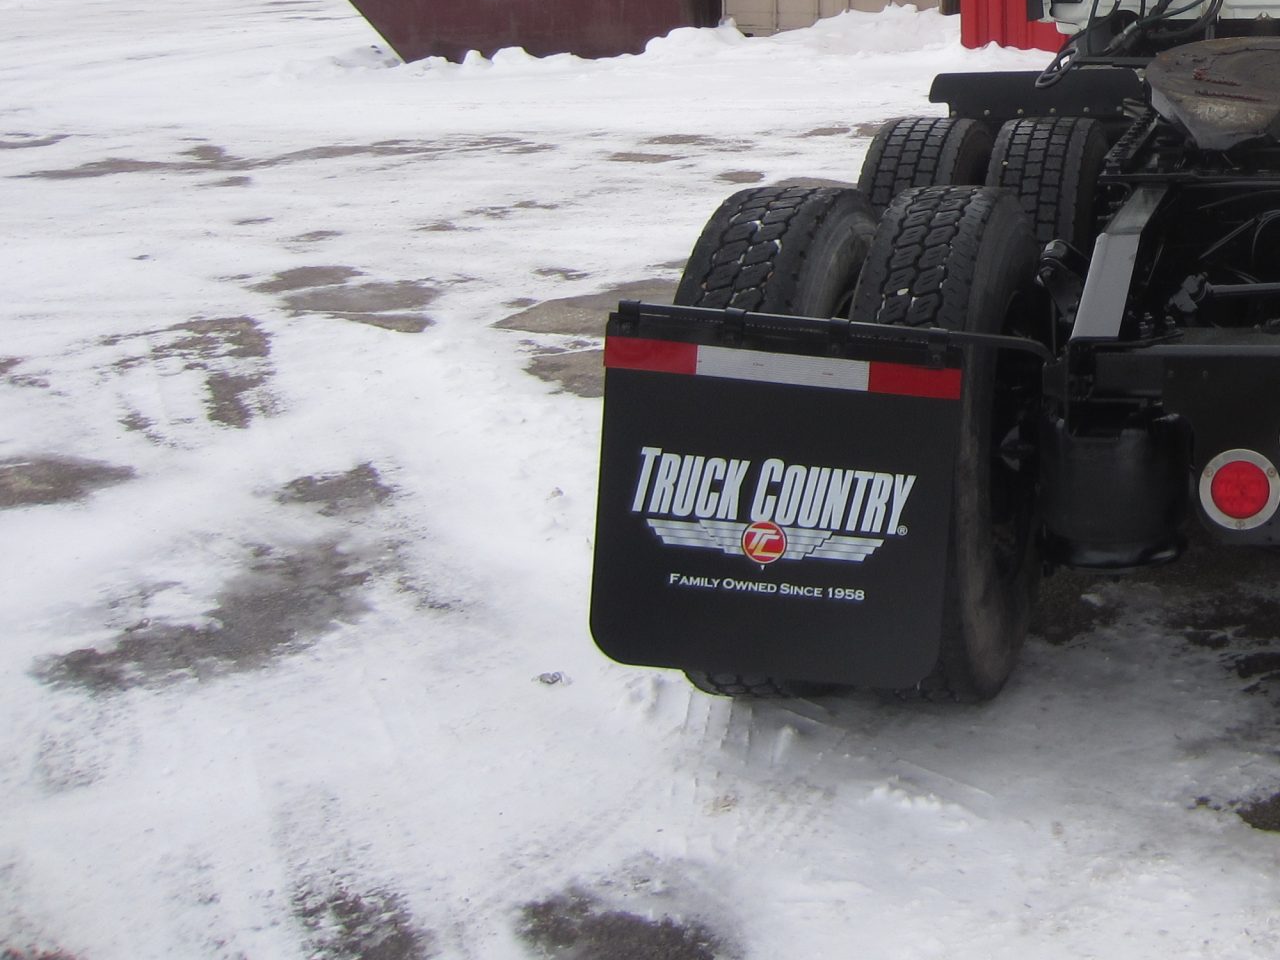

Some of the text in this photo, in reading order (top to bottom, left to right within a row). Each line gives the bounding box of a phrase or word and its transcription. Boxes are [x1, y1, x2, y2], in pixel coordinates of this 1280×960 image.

[632, 446, 917, 535] TRUCK COUNTRY
[669, 573, 865, 601] FAMILY OWNED SINCE 1958
